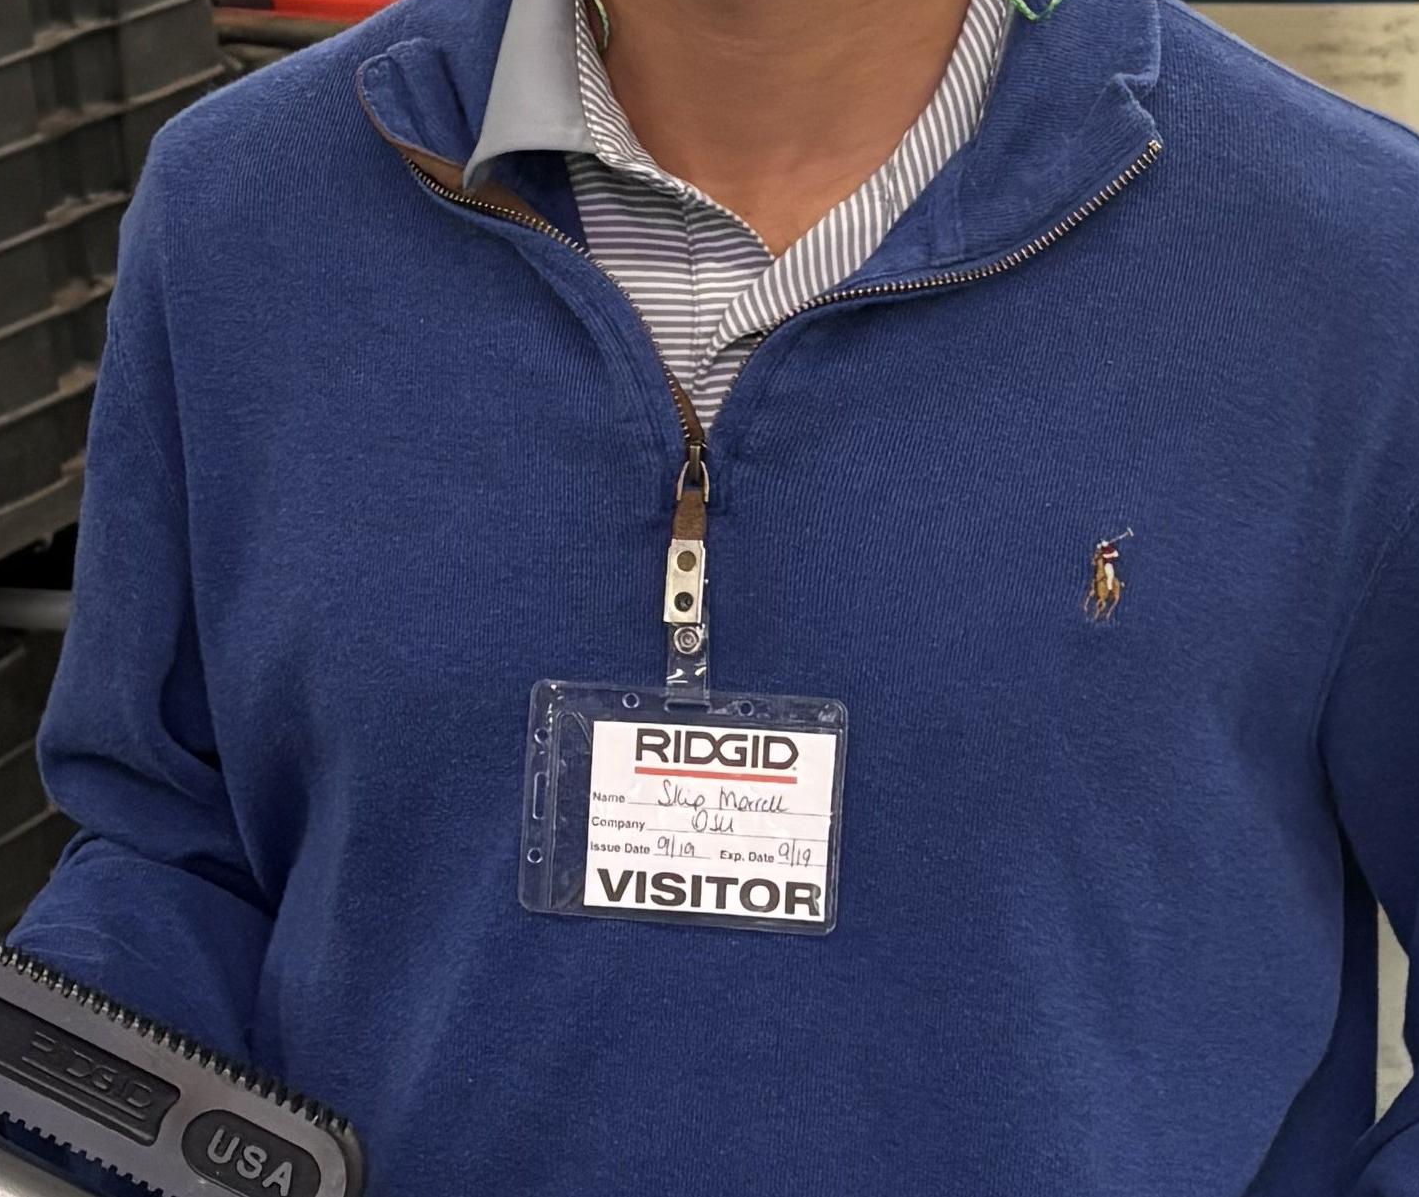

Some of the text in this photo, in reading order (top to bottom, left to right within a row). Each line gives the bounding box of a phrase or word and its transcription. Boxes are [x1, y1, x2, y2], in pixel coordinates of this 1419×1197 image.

[635, 728, 799, 770] RIDGID
[593, 791, 625, 803] Name
[591, 816, 646, 832] Company
[590, 835, 811, 867] Issue Date 9/19 Exp. Date 9/19
[597, 868, 821, 916] VISITOR
[206, 1125, 294, 1197] USA
